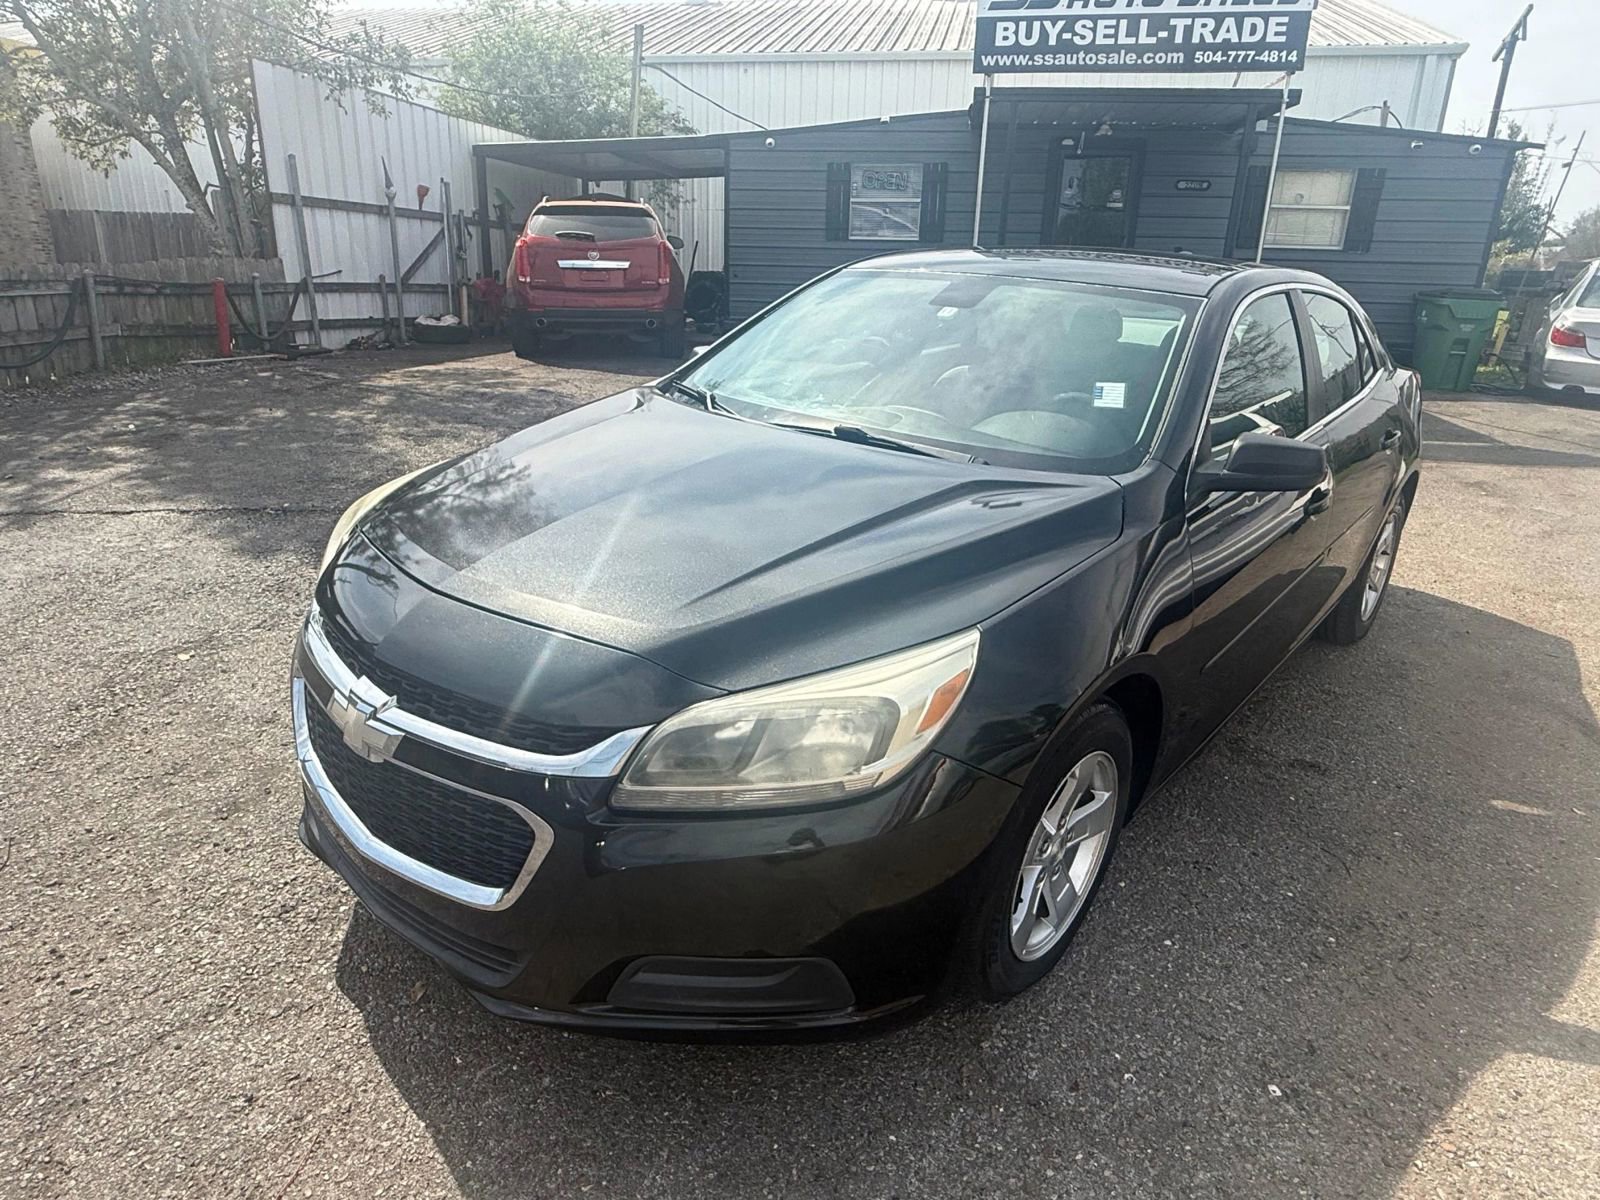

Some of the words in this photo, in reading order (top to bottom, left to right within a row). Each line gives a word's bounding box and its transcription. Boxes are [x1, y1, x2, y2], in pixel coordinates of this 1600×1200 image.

[995, 17, 1289, 46] BUY-SELL-TRADE
[981, 50, 1184, 66] www.ssautosale.com
[1194, 50, 1297, 63] 504-777-4814
[863, 171, 907, 190] OPEN
